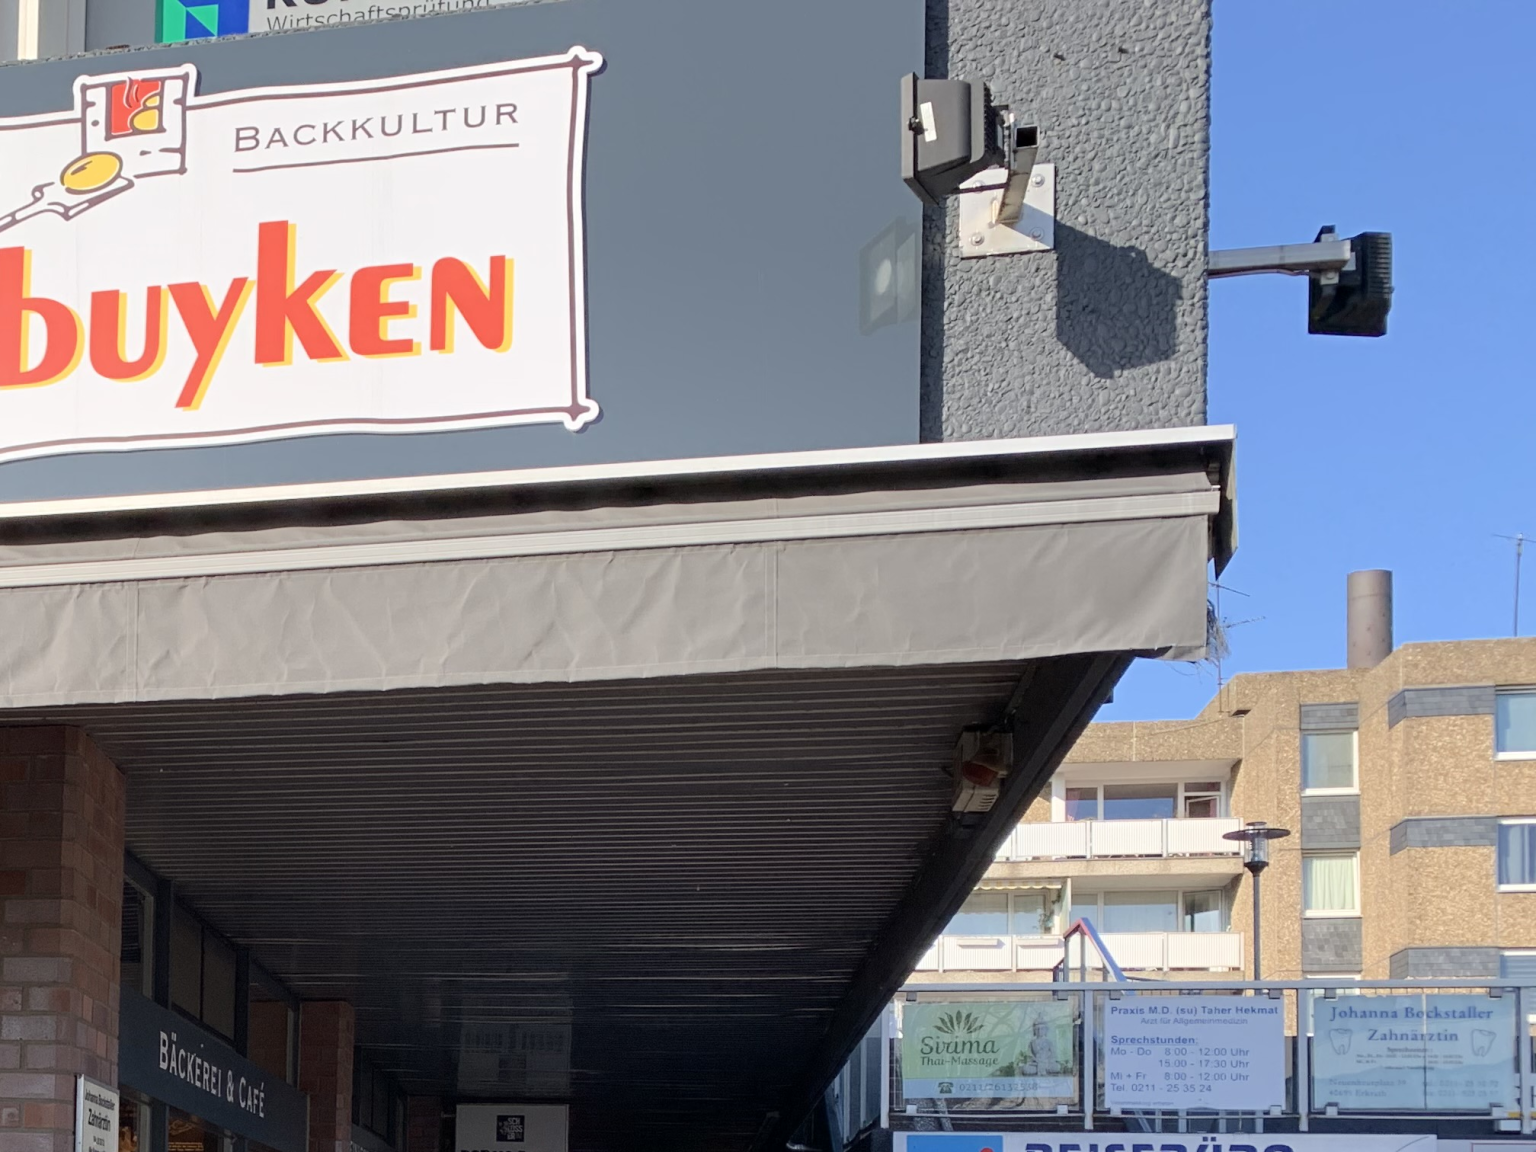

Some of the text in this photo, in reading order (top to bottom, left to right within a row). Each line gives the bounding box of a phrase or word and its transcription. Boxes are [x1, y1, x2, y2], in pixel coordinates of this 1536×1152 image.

[233, 101, 520, 154] BACKKULTUR
[1111, 1006, 1279, 1016] Praxis M.D. (su) Taher Hekmat
[1330, 1006, 1494, 1021] Johanna Bockstaller
[1173, 1018, 1248, 1026] Allgemeinmedizin
[1367, 1029, 1459, 1042] Zahnärztin
[921, 1035, 1001, 1055] Sirima
[1111, 1048, 1127, 1056] Mo
[1137, 1048, 1152, 1056] Do
[1199, 1048, 1227, 1056] 12:00
[1230, 1048, 1250, 1056] Uhr
[921, 1056, 1000, 1067] Thai-Massage
[1199, 1060, 1227, 1068] 17:30
[1230, 1060, 1250, 1068] Uhr
[159, 1030, 265, 1118] BÄCKEREI & CAFÉ
[1111, 1072, 1123, 1080] Mi
[1136, 1072, 1146, 1080] Fr
[1199, 1073, 1227, 1081] 12:00
[1230, 1073, 1250, 1081] Uhr
[1111, 1084, 1127, 1092] Tel.
[1132, 1084, 1155, 1092] 0211
[1167, 1084, 1180, 1093] 25
[1183, 1084, 1196, 1093] 35
[1199, 1084, 1212, 1093] 24
